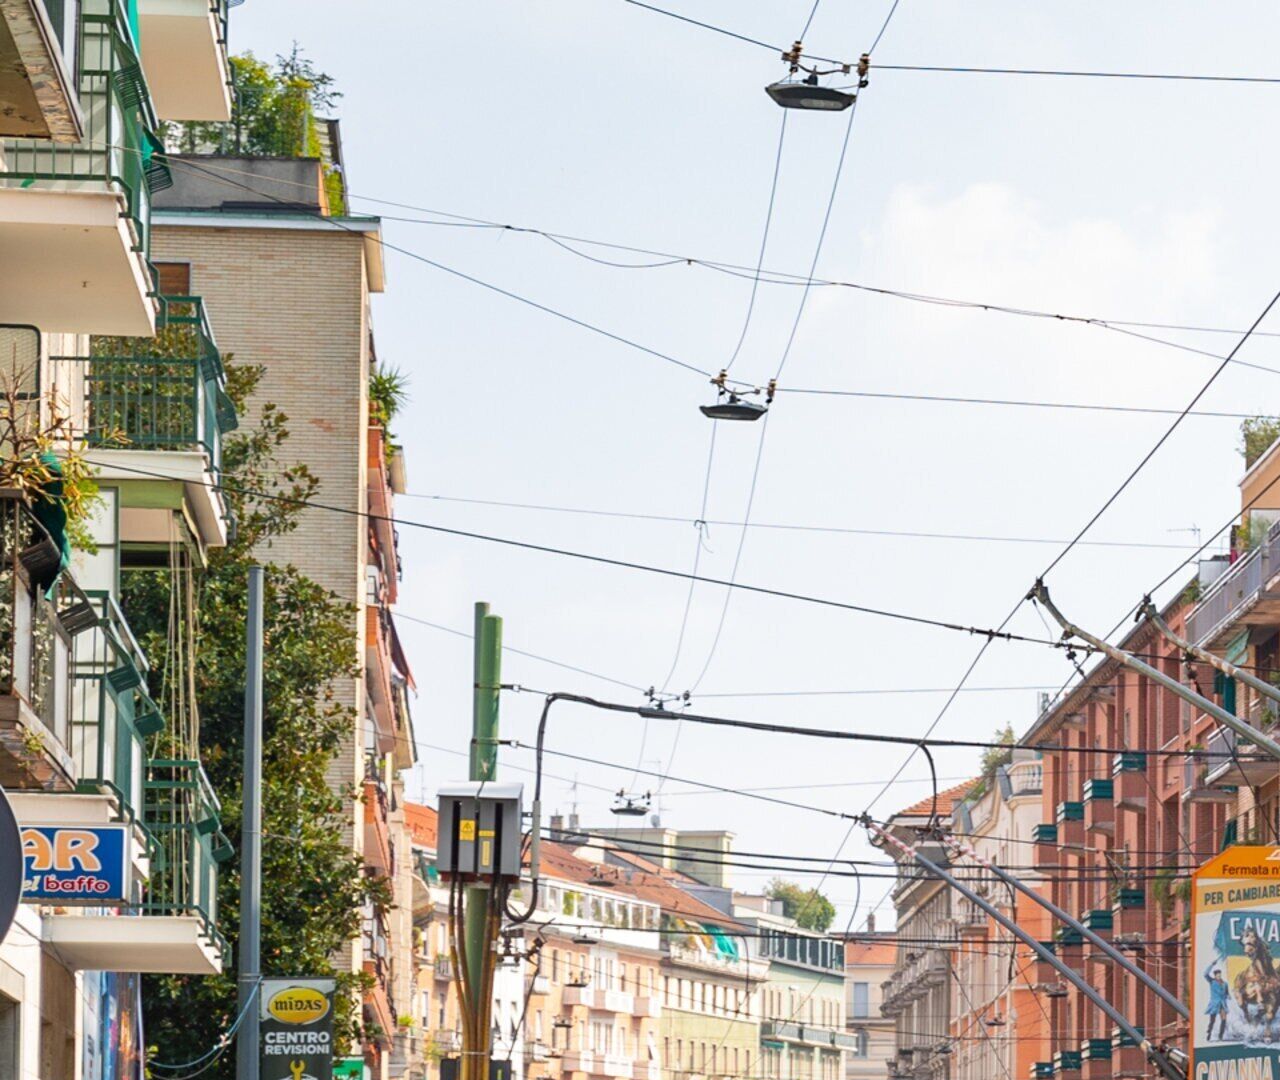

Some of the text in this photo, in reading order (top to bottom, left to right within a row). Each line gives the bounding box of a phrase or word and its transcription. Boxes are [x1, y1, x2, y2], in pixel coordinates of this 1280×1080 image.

[22, 828, 101, 871] AR
[1222, 864, 1269, 876] Fermata
[23, 875, 110, 892] el baffo
[1204, 892, 1224, 906] PER
[1228, 884, 1280, 902] CAMBIARE
[265, 1031, 330, 1044] CENTRO
[265, 1044, 330, 1055] REVISIONI
